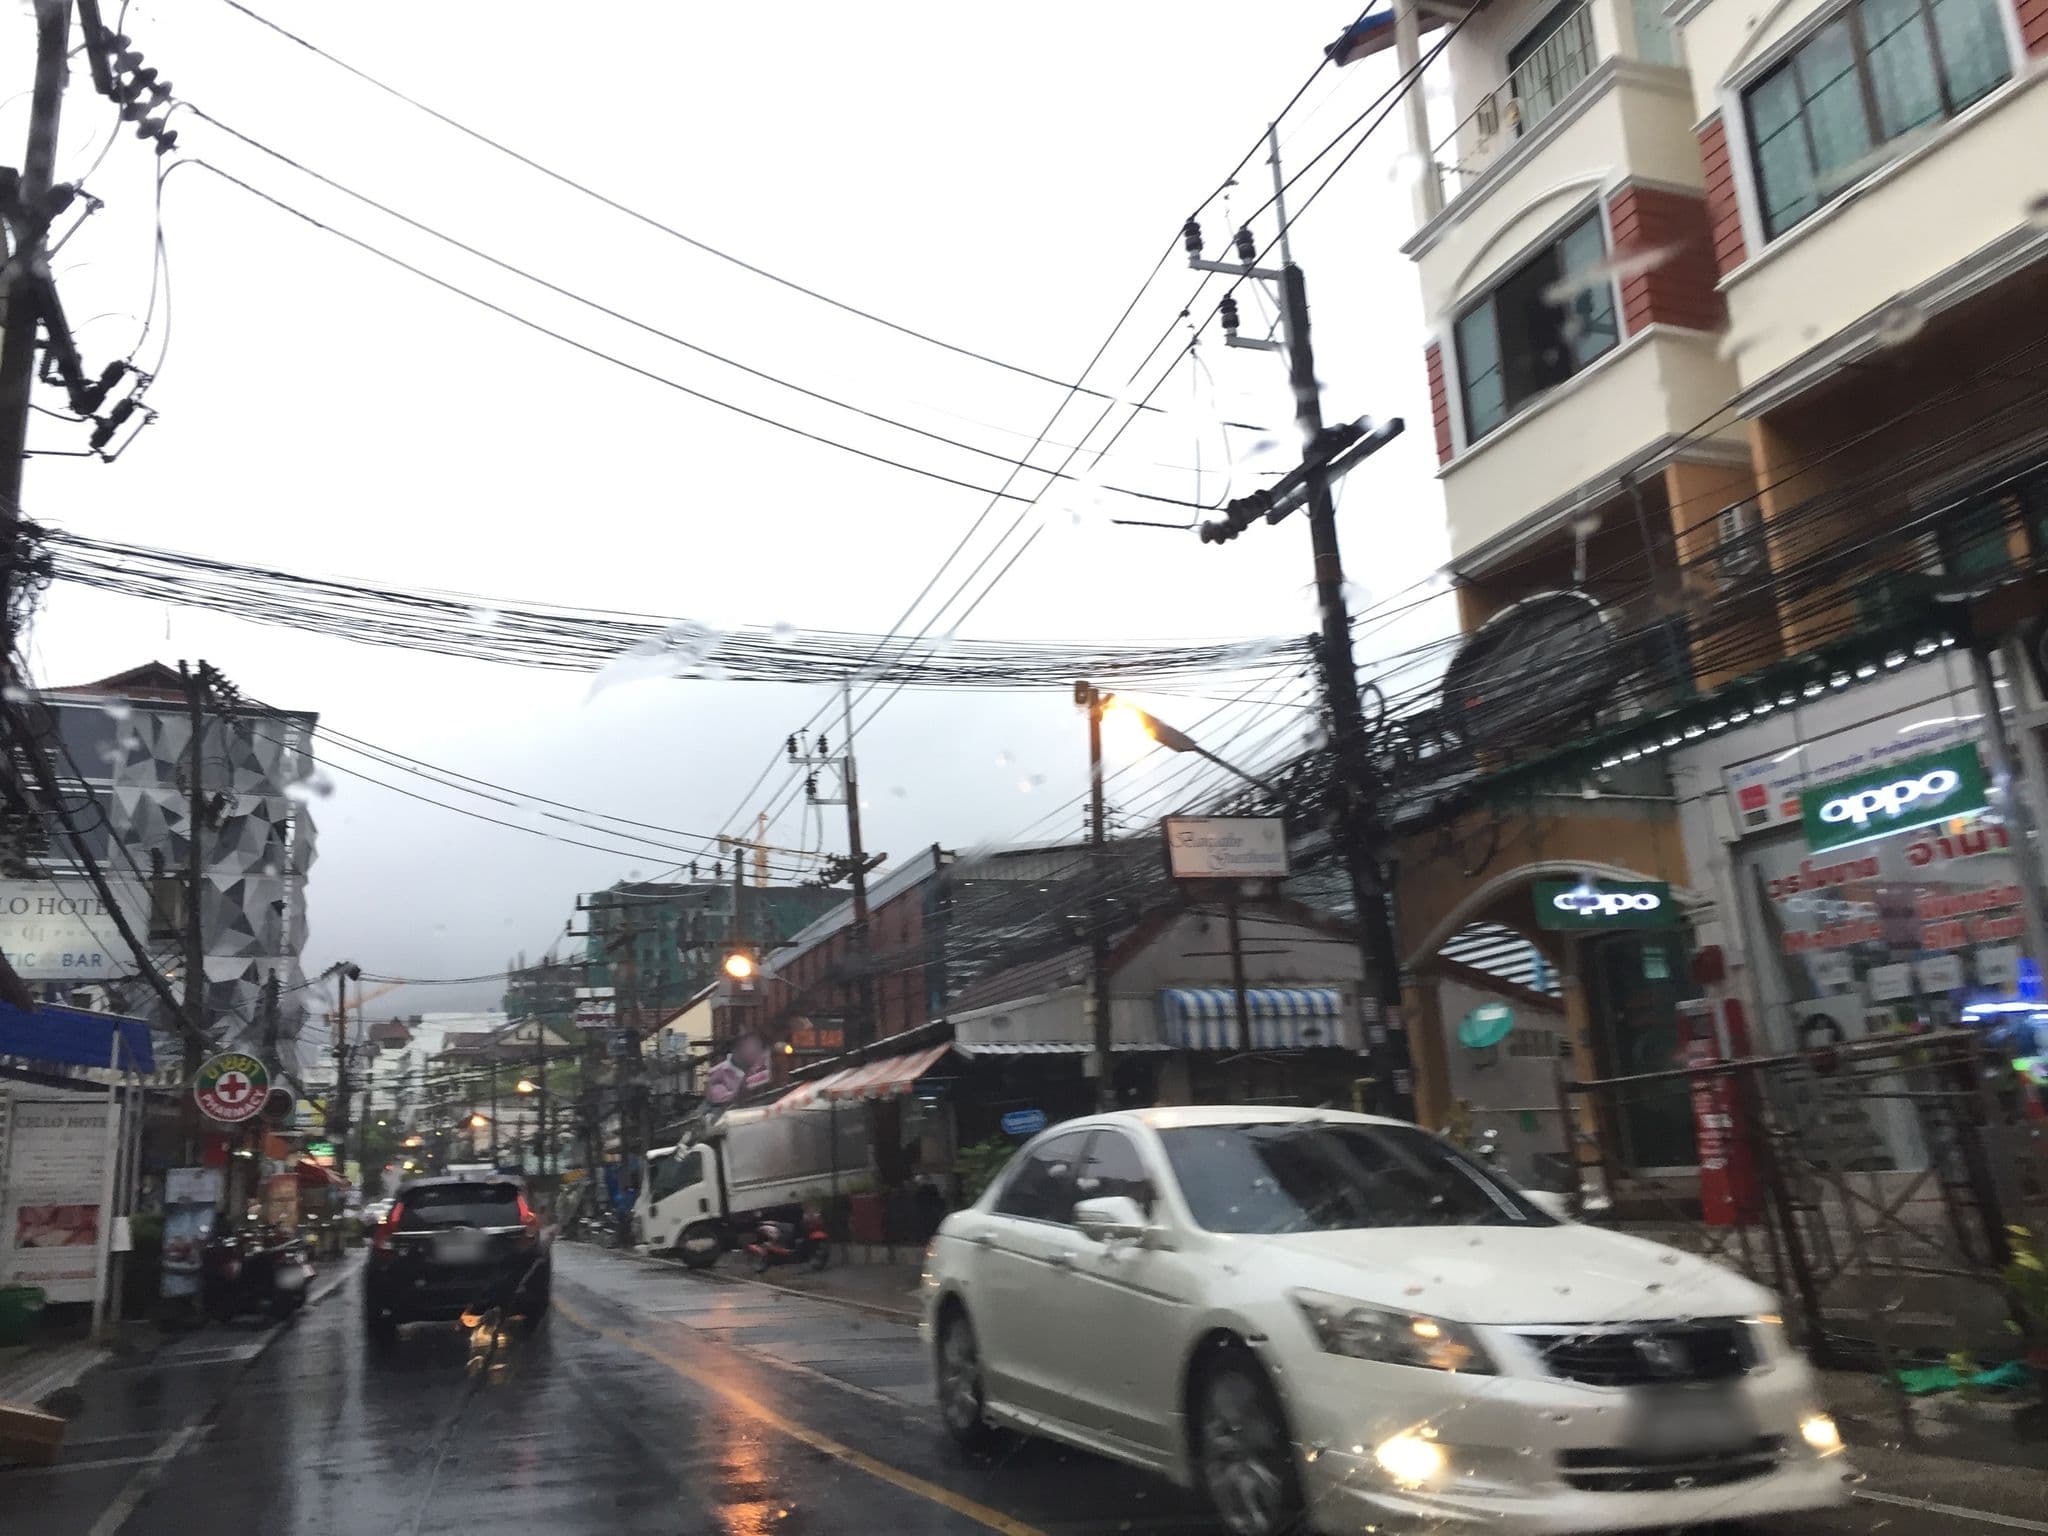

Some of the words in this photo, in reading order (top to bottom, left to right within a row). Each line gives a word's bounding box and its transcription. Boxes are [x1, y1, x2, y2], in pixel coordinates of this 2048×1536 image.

[1820, 769, 1960, 824] oppo
[1553, 893, 1661, 915] oppo
[62, 953, 103, 968] BAR
[201, 1089, 265, 1118] PHARMACY
